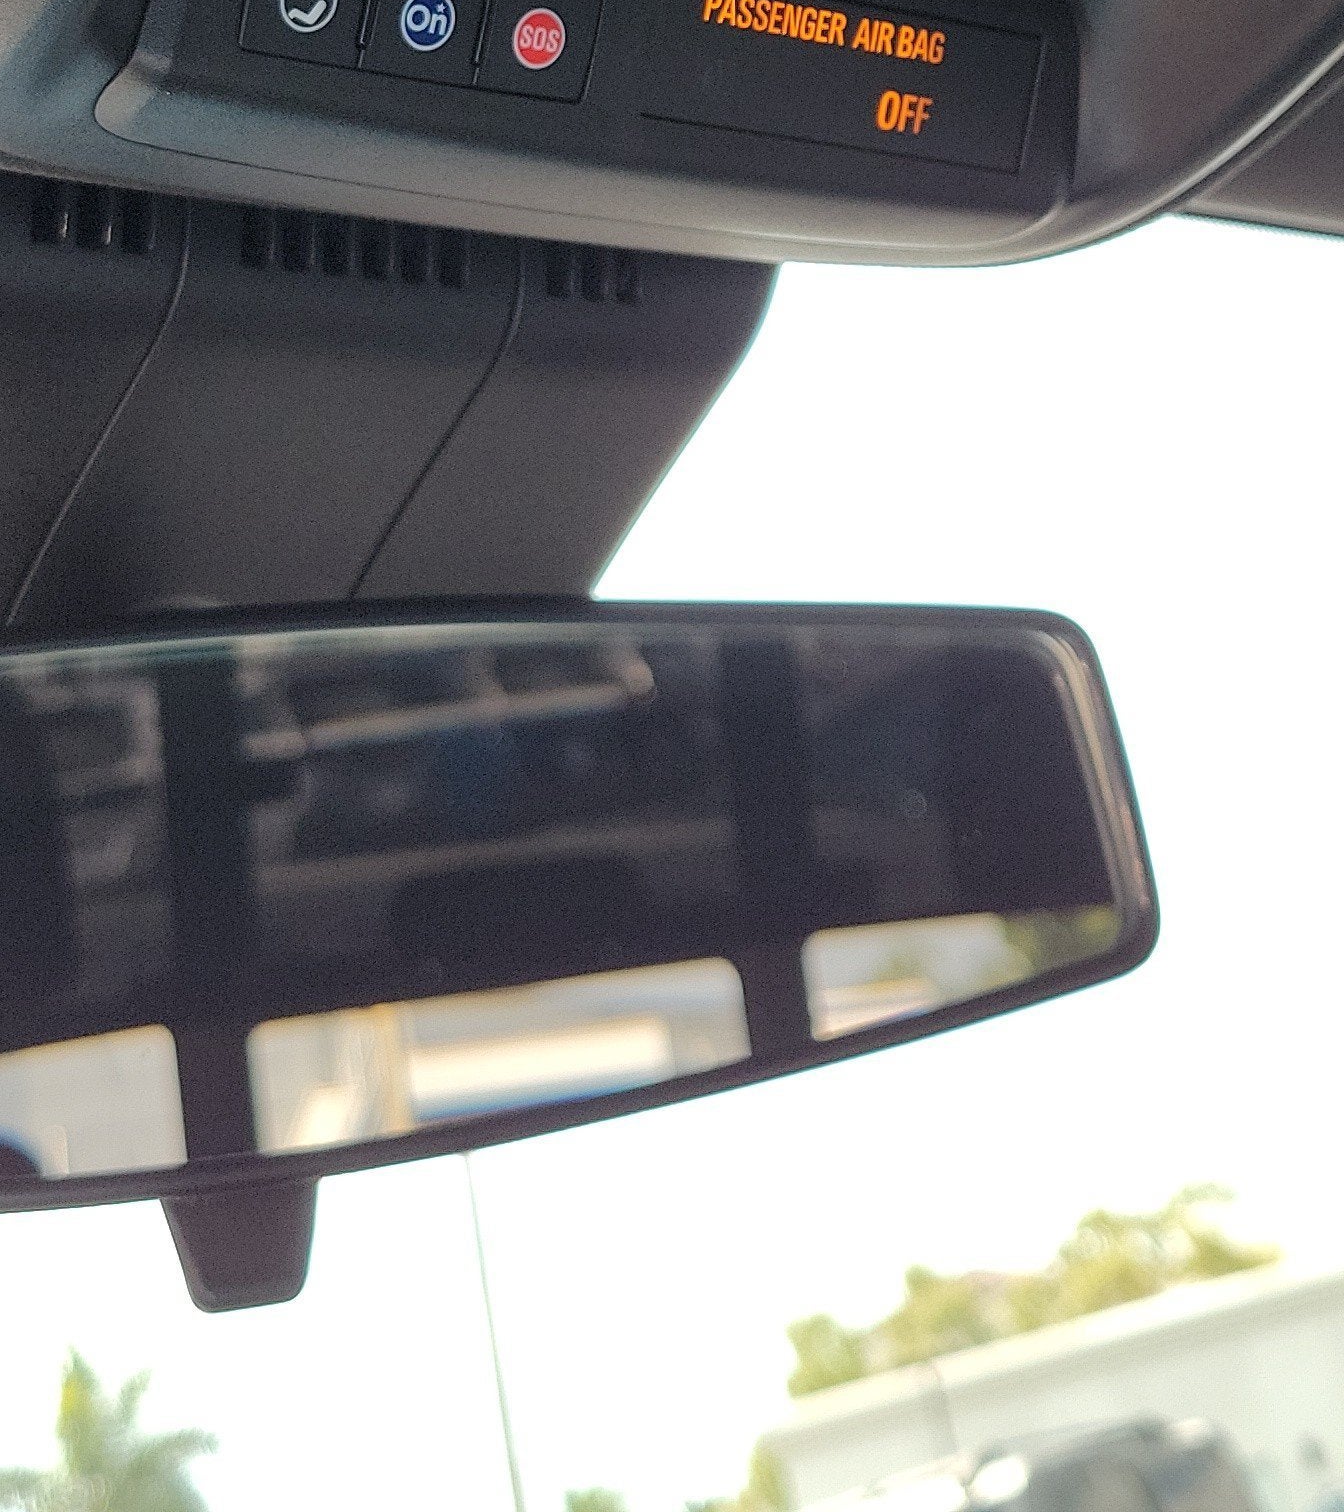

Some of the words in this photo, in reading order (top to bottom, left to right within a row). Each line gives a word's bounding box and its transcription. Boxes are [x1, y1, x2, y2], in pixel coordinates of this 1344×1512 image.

[407, 4, 448, 35] On
[519, 23, 560, 53] SOS
[875, 90, 934, 134] OFF
